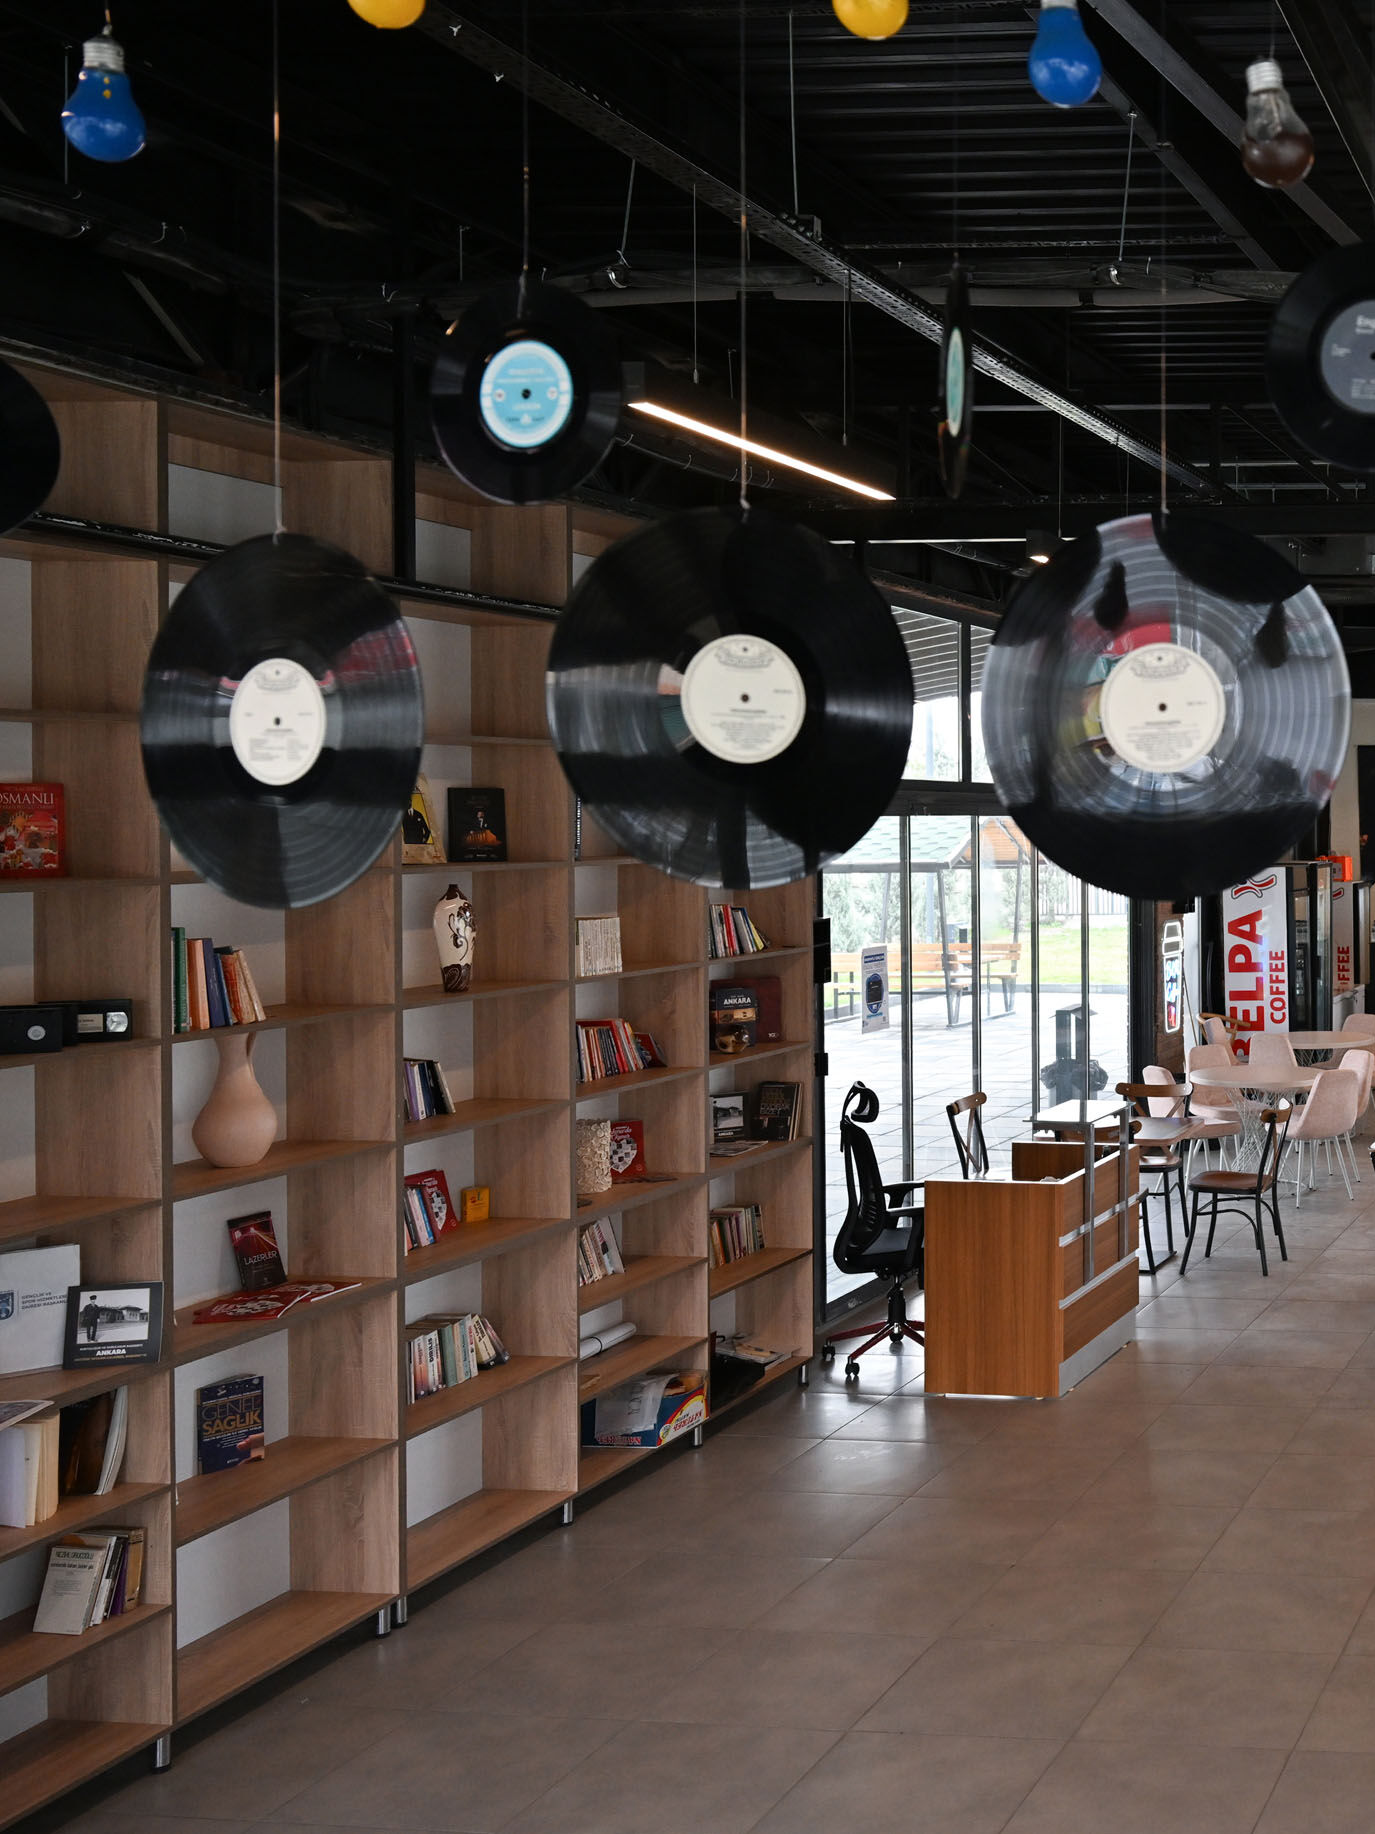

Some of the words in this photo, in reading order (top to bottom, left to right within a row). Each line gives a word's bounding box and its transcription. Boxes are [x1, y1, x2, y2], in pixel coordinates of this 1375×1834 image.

[1337, 946, 1350, 986] FFEE
[1269, 949, 1287, 1025] COFFEE
[723, 997, 752, 1005] ANKARA
[243, 1250, 278, 1265] LAZERLER
[95, 1349, 127, 1357] ANKARA
[201, 1396, 262, 1420] GENEL
